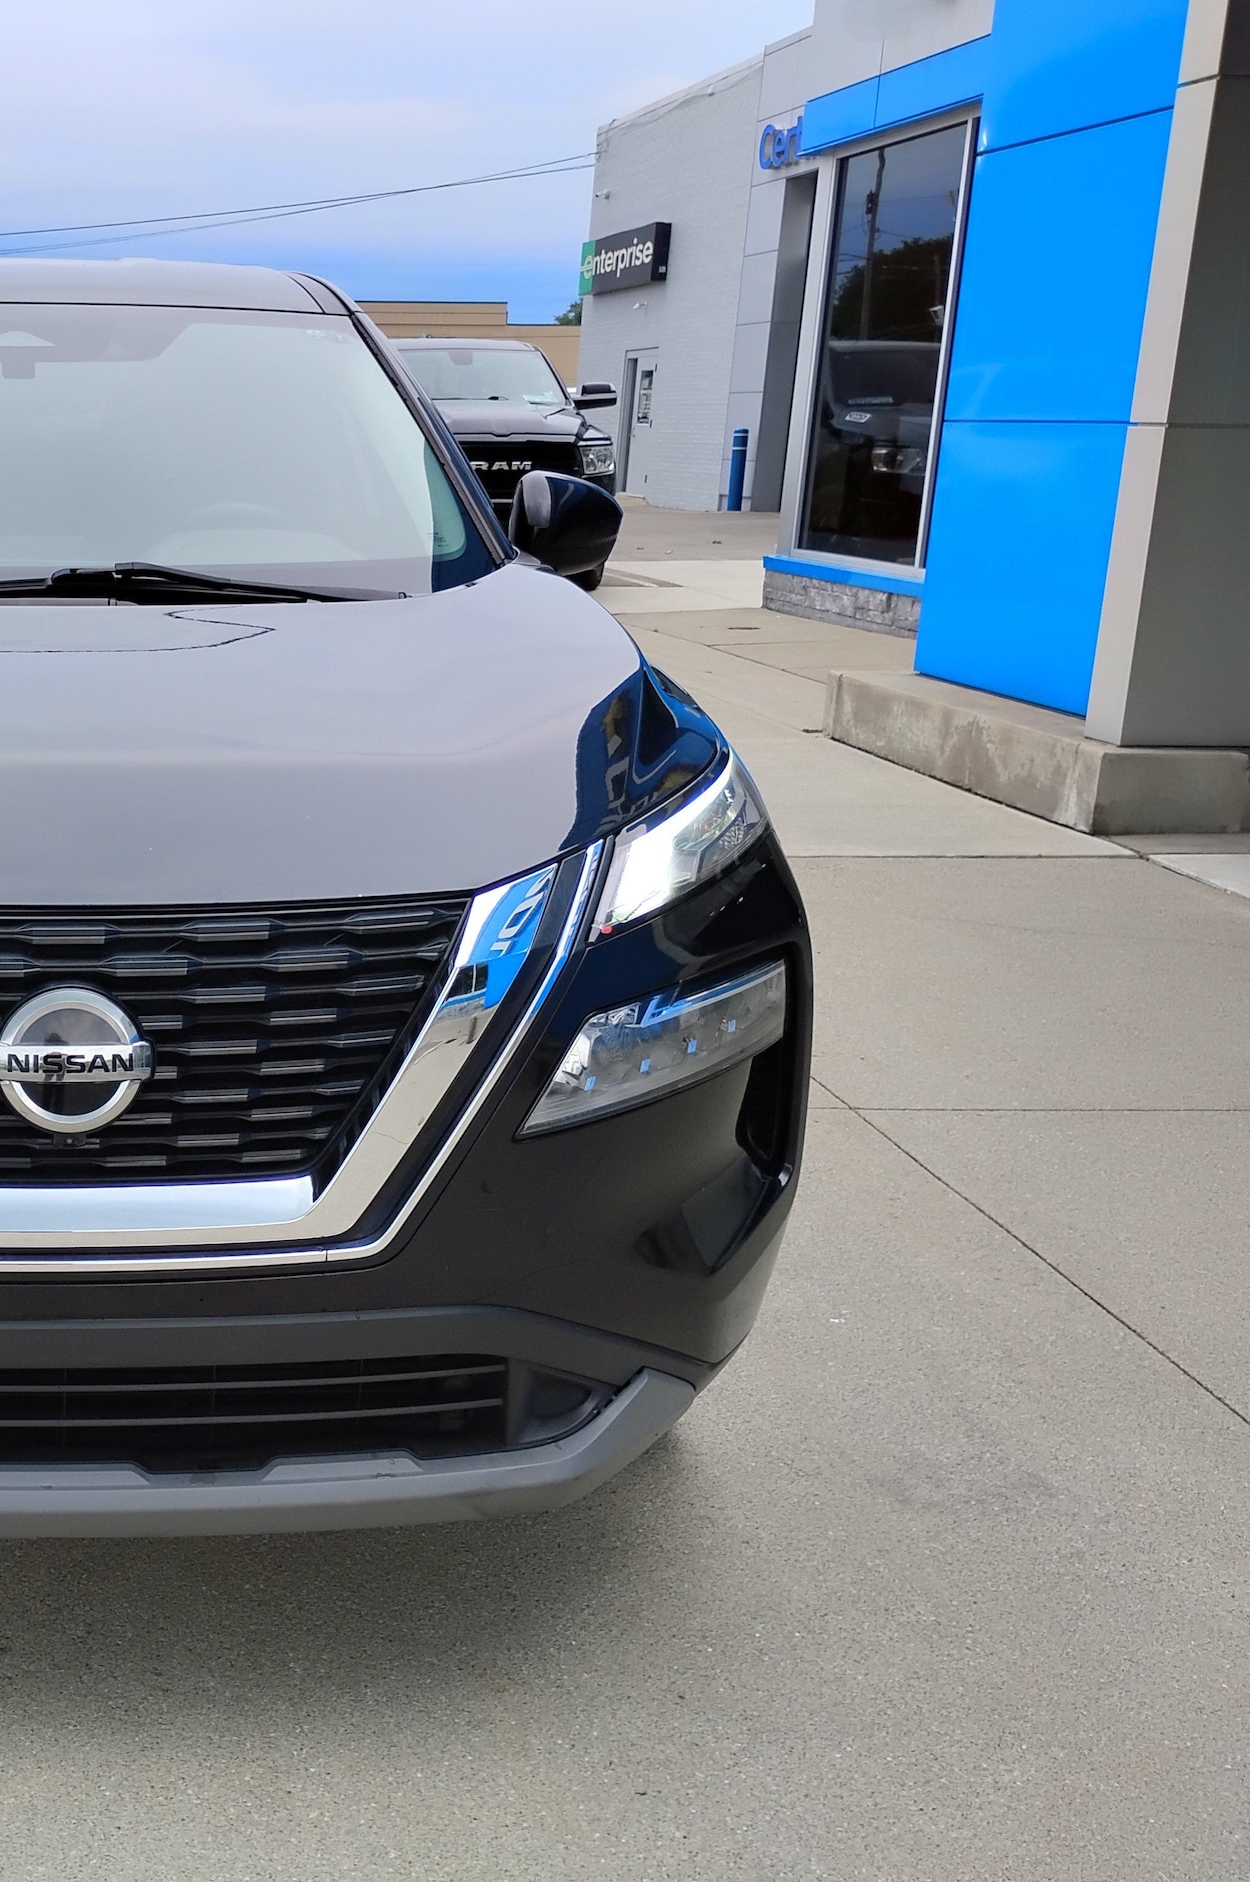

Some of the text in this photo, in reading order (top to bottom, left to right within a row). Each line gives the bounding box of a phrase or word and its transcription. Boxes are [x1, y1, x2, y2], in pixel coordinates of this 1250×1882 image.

[579, 237, 654, 279] enterprise
[469, 461, 532, 471] RAM
[7, 1053, 134, 1073] NISSAN
